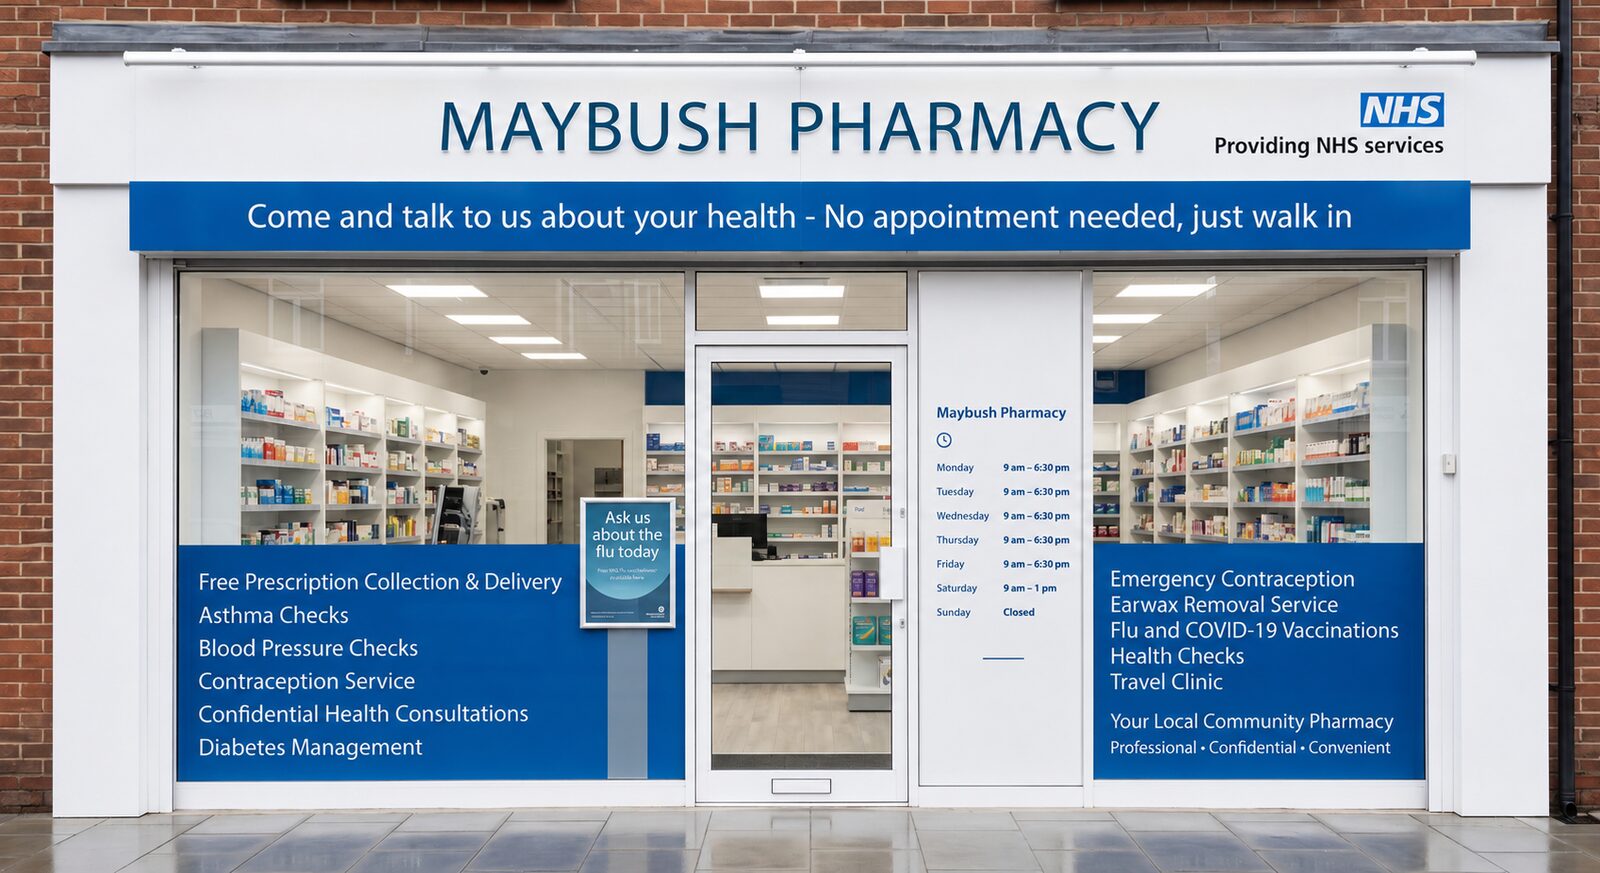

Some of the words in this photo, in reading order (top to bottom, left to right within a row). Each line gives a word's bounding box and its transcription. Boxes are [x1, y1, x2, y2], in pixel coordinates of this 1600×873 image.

[1363, 95, 1442, 124] NHS
[441, 101, 756, 152] MAYBUSH
[791, 101, 1160, 152] PHARMACY
[1216, 136, 1309, 158] Providing
[1317, 137, 1358, 153] NHS
[1365, 136, 1443, 153] services
[248, 204, 330, 228] Come
[340, 203, 392, 228] and
[403, 203, 454, 228] talk
[463, 206, 491, 228] to
[502, 210, 531, 228] us
[542, 203, 624, 228] about
[634, 210, 697, 235] your
[709, 203, 795, 228] health
[826, 204, 863, 228] No
[874, 204, 1059, 235] appointment
[1070, 203, 1182, 232] needed,
[1191, 204, 1243, 235] just
[1253, 203, 1318, 228] walk
[1328, 204, 1351, 228] in
[937, 406, 996, 421] Maybush
[1001, 407, 1066, 421] Pharmacy
[937, 463, 974, 473] Monday
[1003, 464, 1009, 472] 9
[1033, 464, 1053, 472] 6:30
[1054, 465, 1069, 473] pm
[937, 487, 974, 497] Tuesday
[1003, 488, 1009, 496] 9
[1033, 488, 1053, 496] 6:30
[605, 511, 630, 524] Ask
[635, 513, 651, 524] us
[937, 512, 989, 522] Wednesday
[1003, 512, 1009, 520] 9
[1033, 512, 1053, 520] 6:30
[1054, 514, 1070, 522] pm
[592, 528, 637, 541] about
[639, 528, 663, 541] the
[937, 536, 979, 546] Thursday
[1003, 536, 1009, 544] 9
[1033, 536, 1053, 544] 6:30
[1054, 538, 1069, 546] pm
[596, 545, 614, 558] flu
[619, 545, 659, 561] today
[937, 560, 964, 570] Friday
[1003, 560, 1009, 568] 9
[1033, 560, 1053, 568] 6:30
[1054, 562, 1069, 570] pm
[200, 573, 239, 590] Free
[246, 573, 358, 595] Prescription
[365, 572, 459, 590] Collection
[466, 573, 479, 590] &
[486, 572, 562, 594] Delivery
[937, 584, 977, 594] Saturday
[1003, 584, 1009, 592] 9
[1034, 584, 1039, 592] 1
[1041, 586, 1056, 594] pm
[1112, 570, 1216, 591] Emergency
[1222, 570, 1354, 591] Contraception
[1112, 596, 1178, 613] Earwax
[1185, 595, 1264, 613] Removal
[1272, 596, 1338, 612] Service
[199, 606, 273, 623] Asthma
[280, 606, 348, 623] Checks
[937, 608, 970, 618] Sunday
[1003, 608, 1034, 616] Closed
[1112, 621, 1137, 638] Flu
[1145, 621, 1179, 638] and
[1186, 622, 1277, 638] COVID-19
[1282, 622, 1398, 638] Vaccinations
[200, 638, 255, 656] Blood
[263, 640, 343, 656] Pressure
[350, 638, 417, 656] Checks
[1112, 647, 1171, 664] Health
[1178, 647, 1244, 664] Checks
[199, 673, 338, 694] Contraception
[346, 672, 415, 689] Service
[1110, 673, 1165, 690] Travel
[1172, 673, 1223, 690] Clinic
[199, 705, 318, 723] Confidential
[326, 704, 388, 722] Health
[396, 704, 528, 722] Consultations
[1111, 713, 1149, 729] Your
[1155, 713, 1197, 728] Local
[1204, 713, 1304, 733] Community
[1311, 713, 1394, 733] Pharmacy
[200, 738, 285, 756] Diabetes
[292, 738, 422, 760] Management
[1111, 740, 1196, 754] Professional
[1210, 740, 1296, 754] Confidential
[1309, 741, 1391, 754] Convenient
